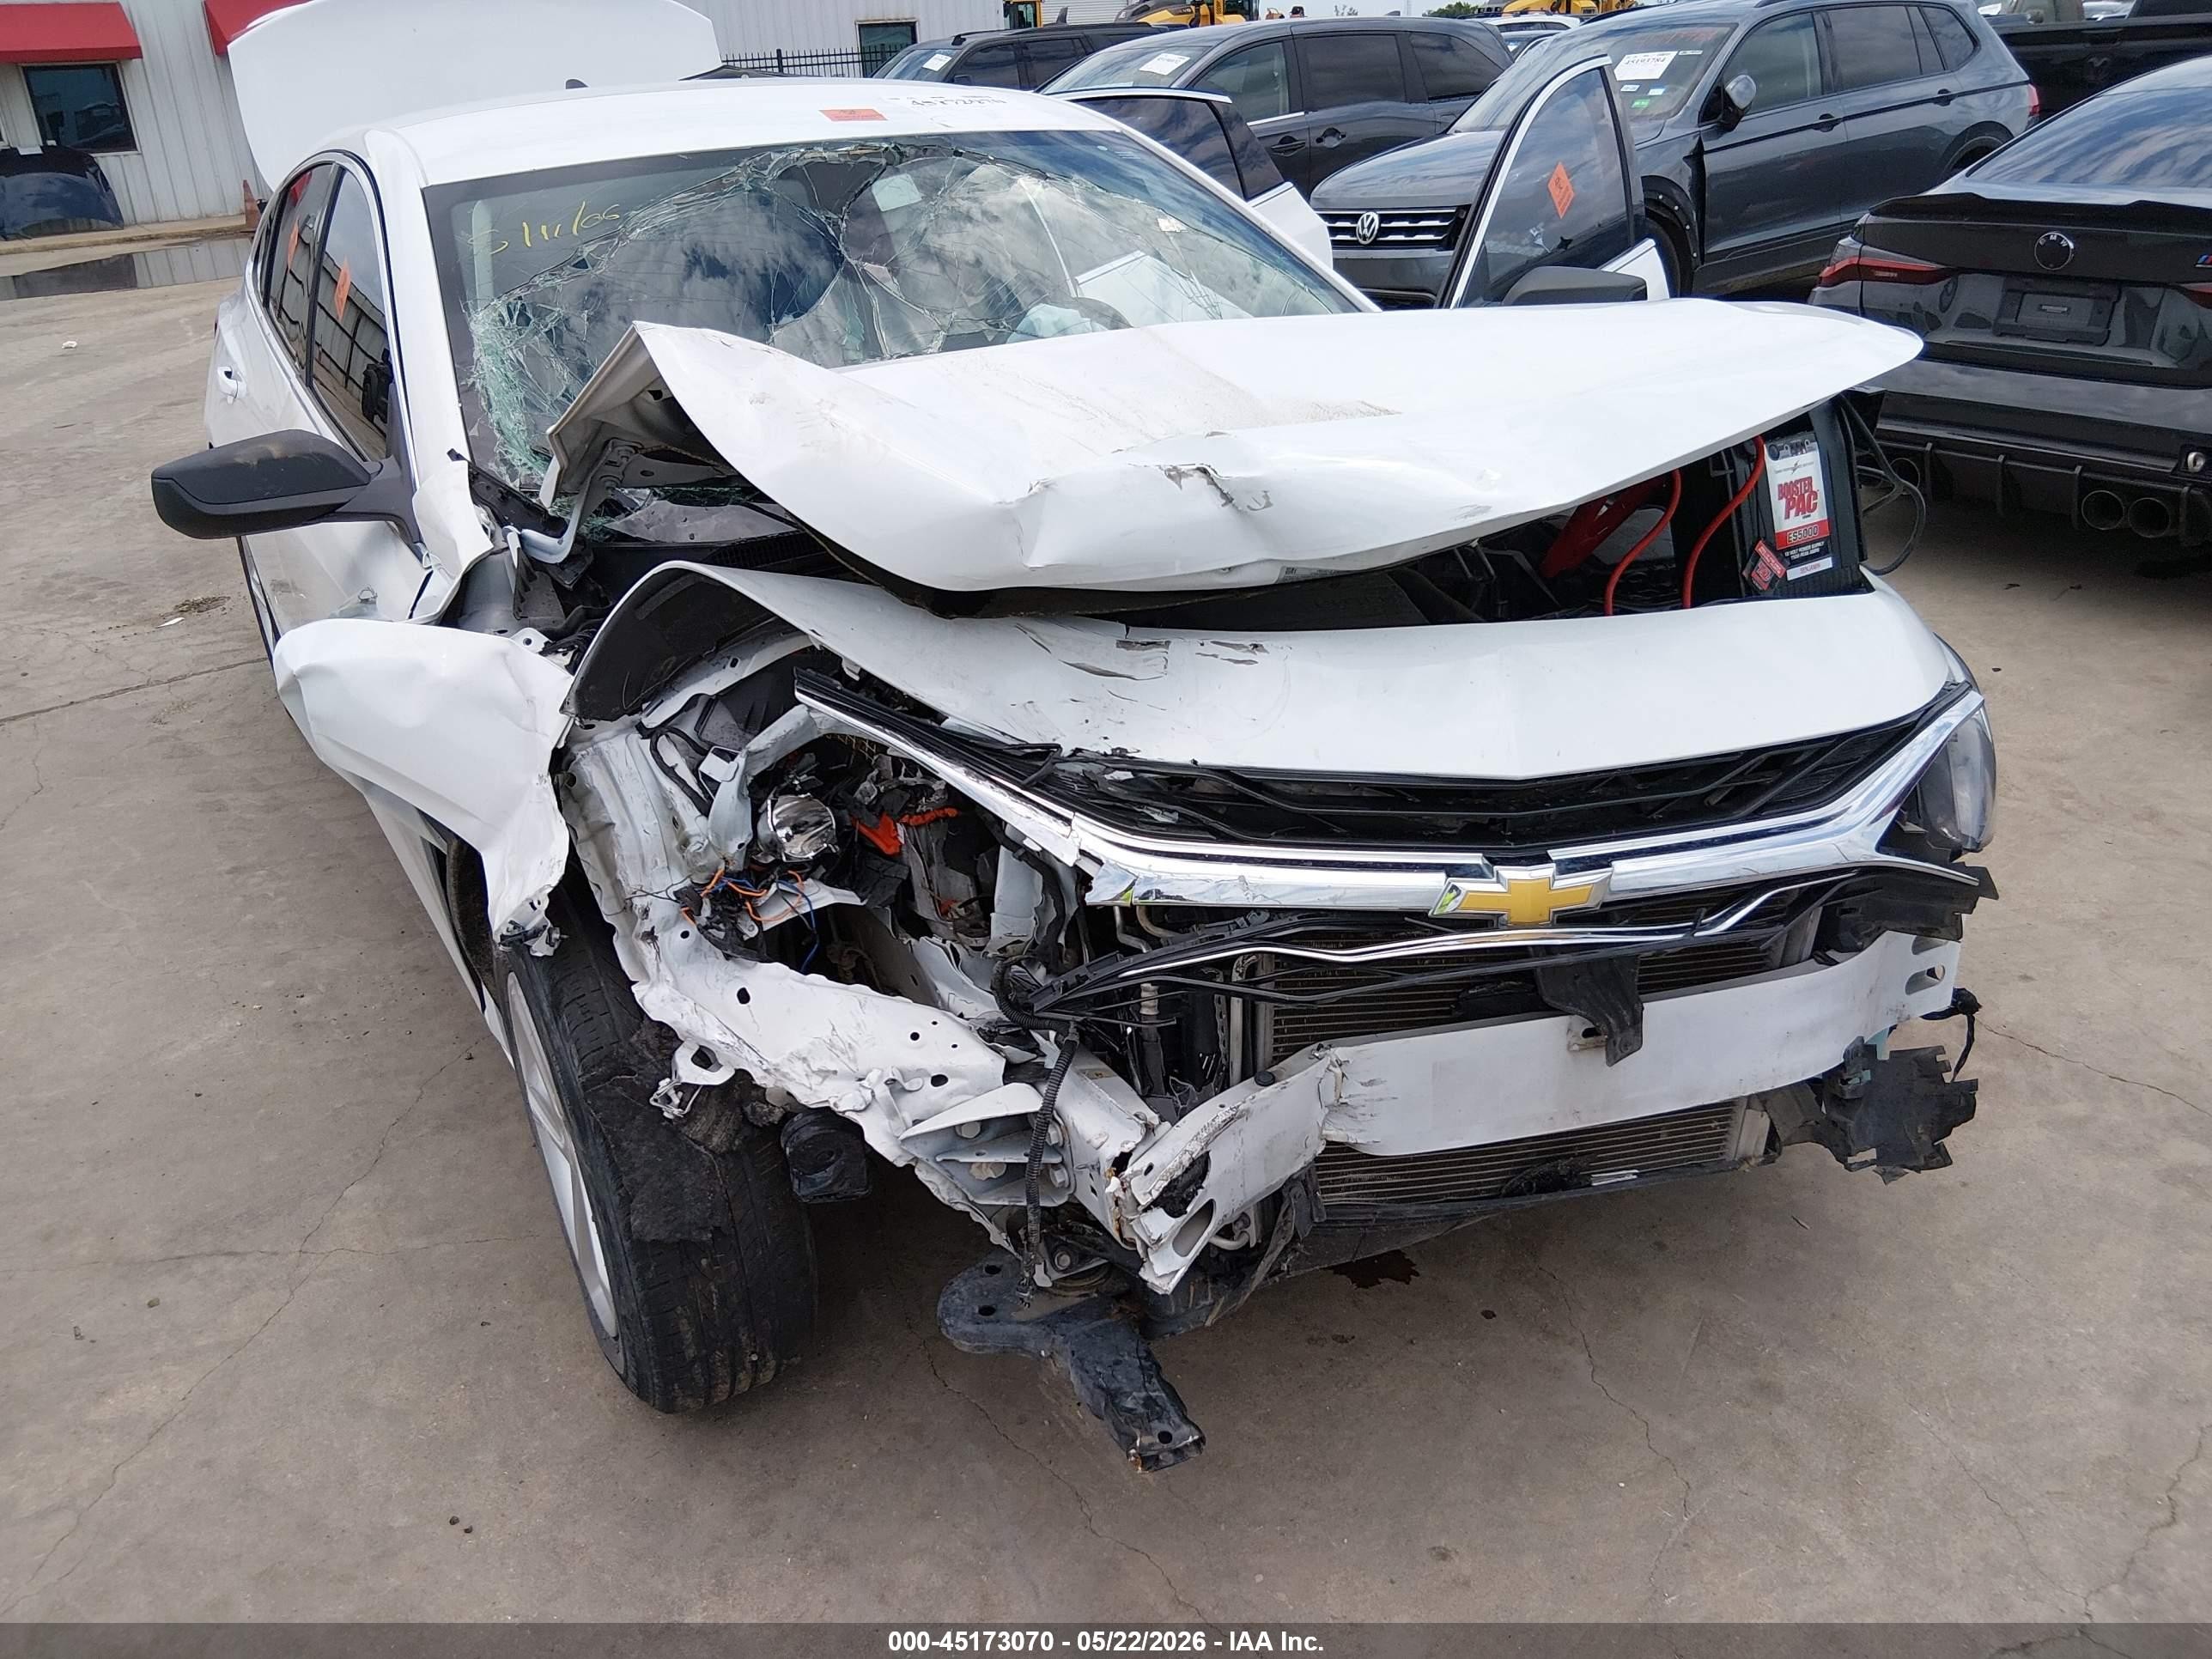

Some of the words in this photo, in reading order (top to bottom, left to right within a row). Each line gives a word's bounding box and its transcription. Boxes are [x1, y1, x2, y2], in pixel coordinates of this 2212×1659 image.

[1778, 476, 1814, 501] BOOSTER
[1784, 491, 1818, 520] PAC
[1787, 525, 1819, 544] ES5000
